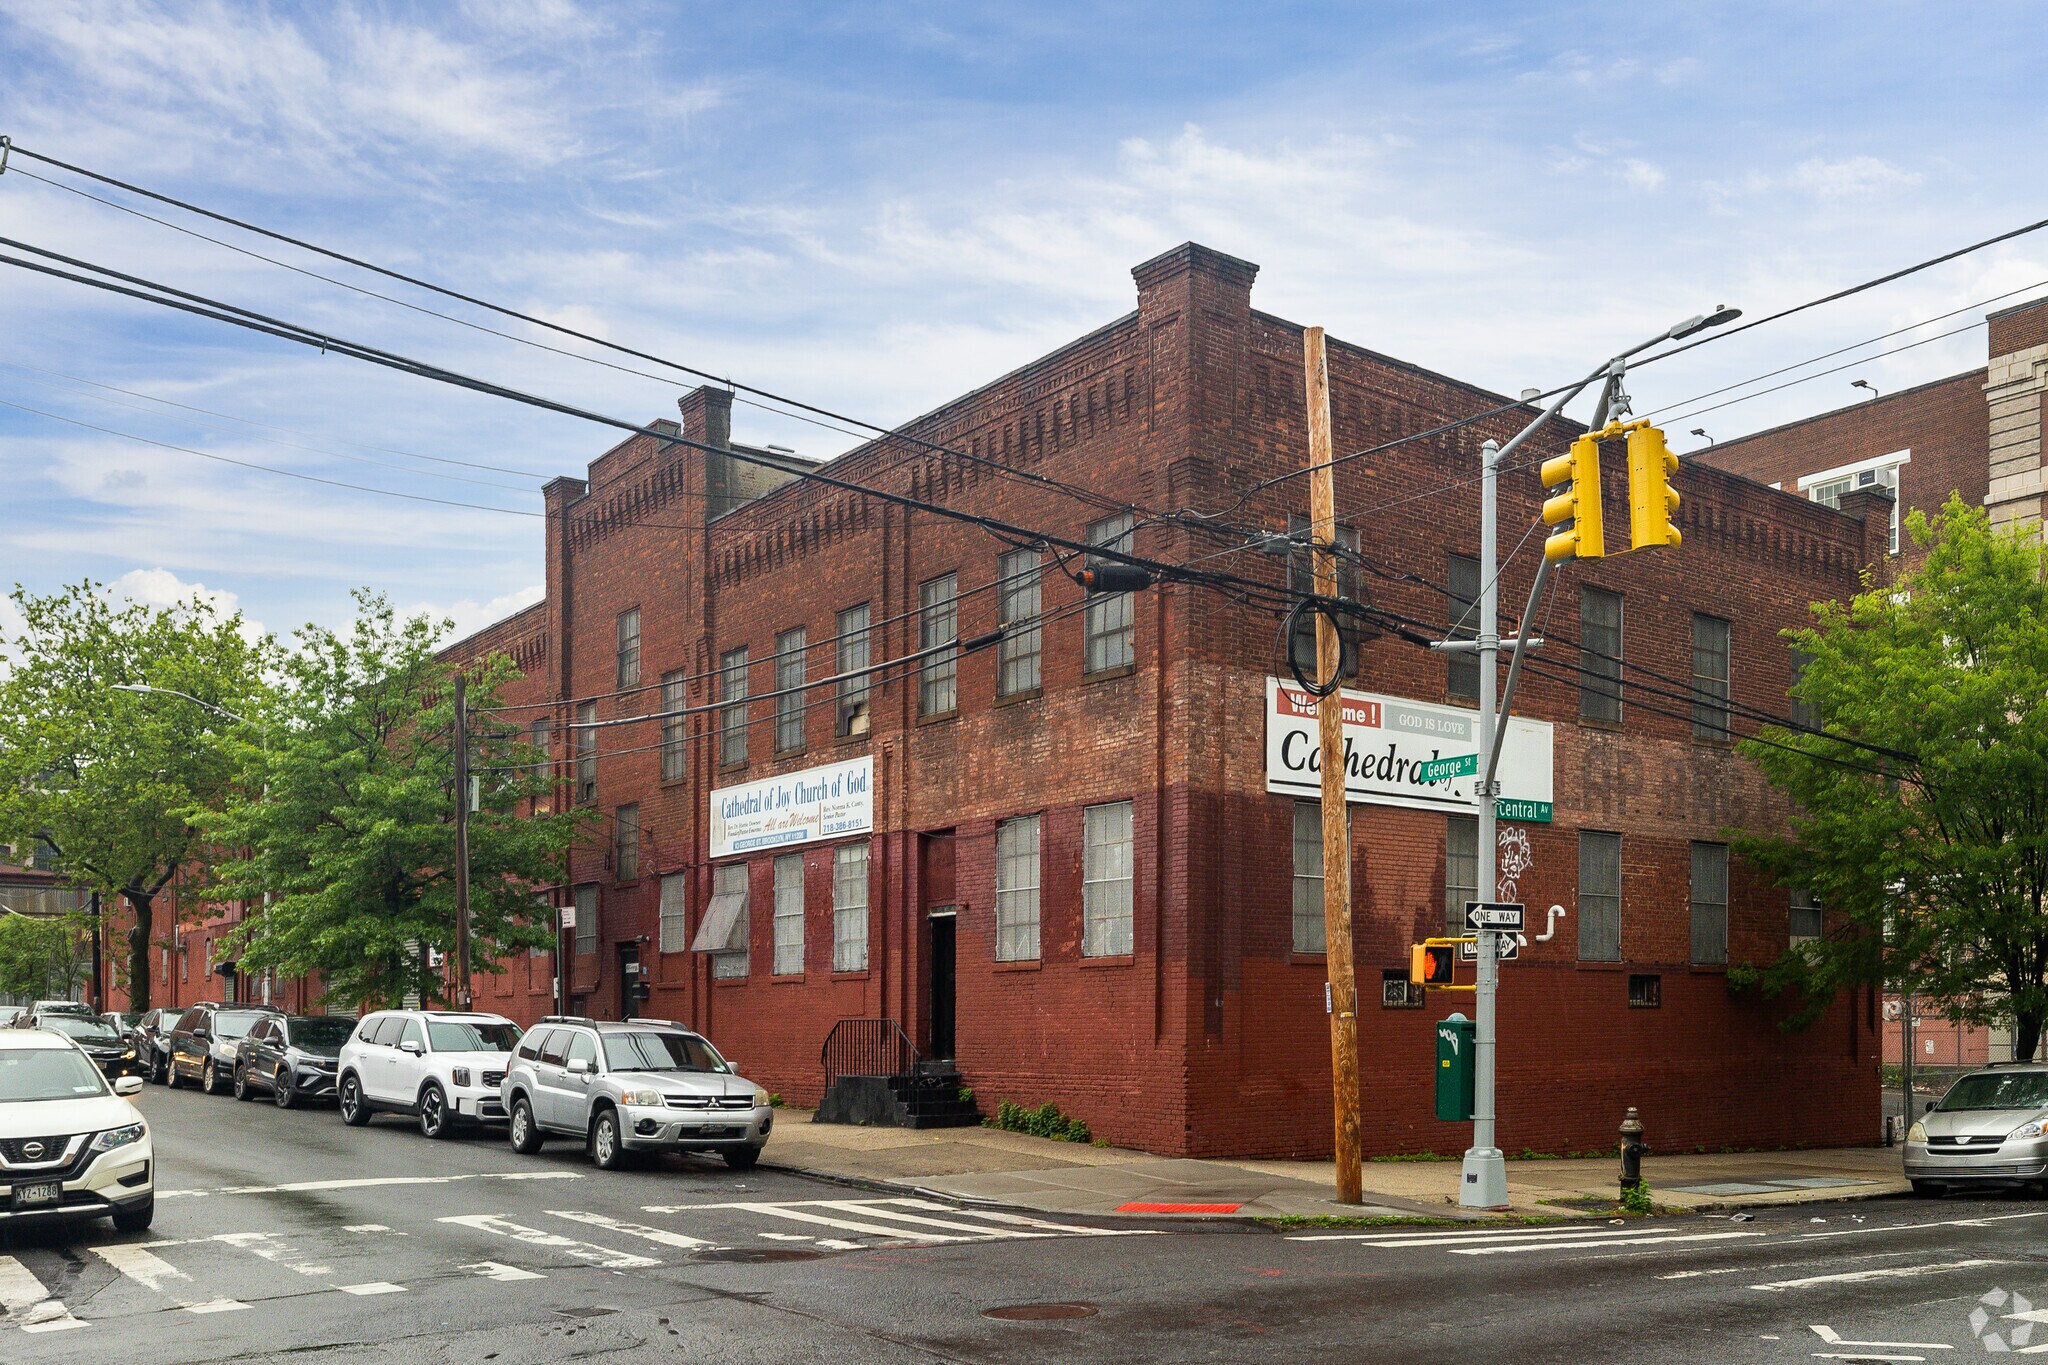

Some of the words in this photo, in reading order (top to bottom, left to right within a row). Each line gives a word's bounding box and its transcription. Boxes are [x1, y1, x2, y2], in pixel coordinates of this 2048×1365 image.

[1290, 692, 1366, 723] Weme
[1399, 713, 1422, 728] GOD
[1425, 718, 1435, 730] IS
[1438, 720, 1465, 735] LOVE
[1281, 730, 1440, 787] Chedra
[1427, 761, 1462, 778] George
[1464, 757, 1471, 767] St
[722, 790, 761, 819] Cathedral
[764, 788, 774, 811] of
[776, 785, 792, 812] Joy
[795, 777, 827, 805] Church
[831, 773, 843, 798] of
[847, 768, 866, 795] God
[1499, 802, 1538, 819] Central
[1540, 804, 1549, 814] Av
[763, 817, 777, 833] All
[778, 820, 788, 829] are
[789, 813, 819, 828] Welcome
[823, 819, 862, 833] 718-386-8151
[740, 839, 756, 849] GEORGE
[1474, 911, 1491, 922] ONE
[1499, 912, 1517, 923] WAY
[1466, 942, 1478, 953] ON
